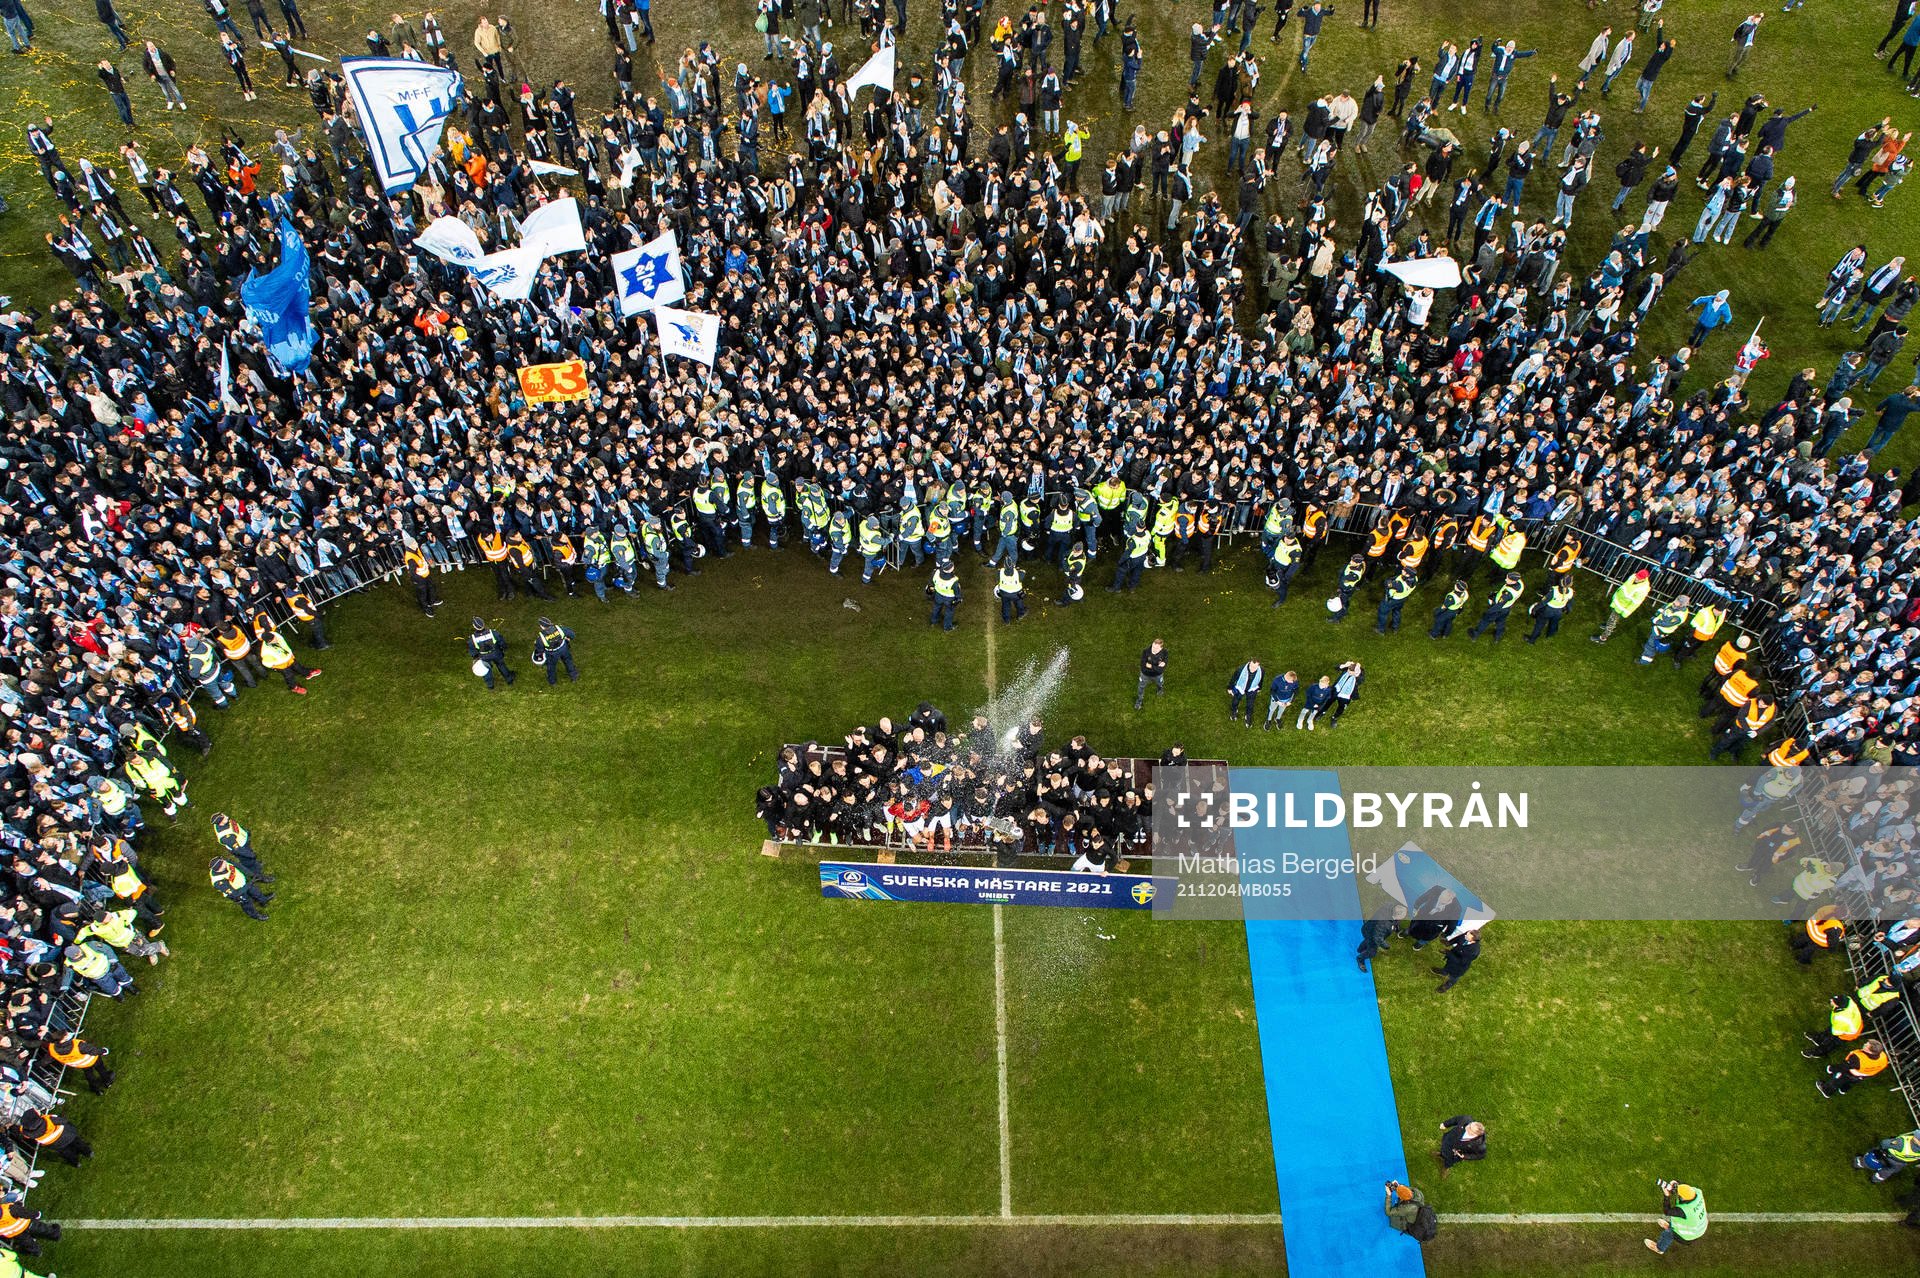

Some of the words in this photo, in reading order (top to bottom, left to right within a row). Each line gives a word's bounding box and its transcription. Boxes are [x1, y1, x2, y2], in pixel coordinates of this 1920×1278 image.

[635, 260, 655, 273] 24
[642, 278, 655, 292] 2
[521, 363, 588, 397] 93
[882, 875, 968, 889] SVENSKA
[974, 876, 1061, 893] MÄSTARE
[1066, 883, 1113, 895] 2021
